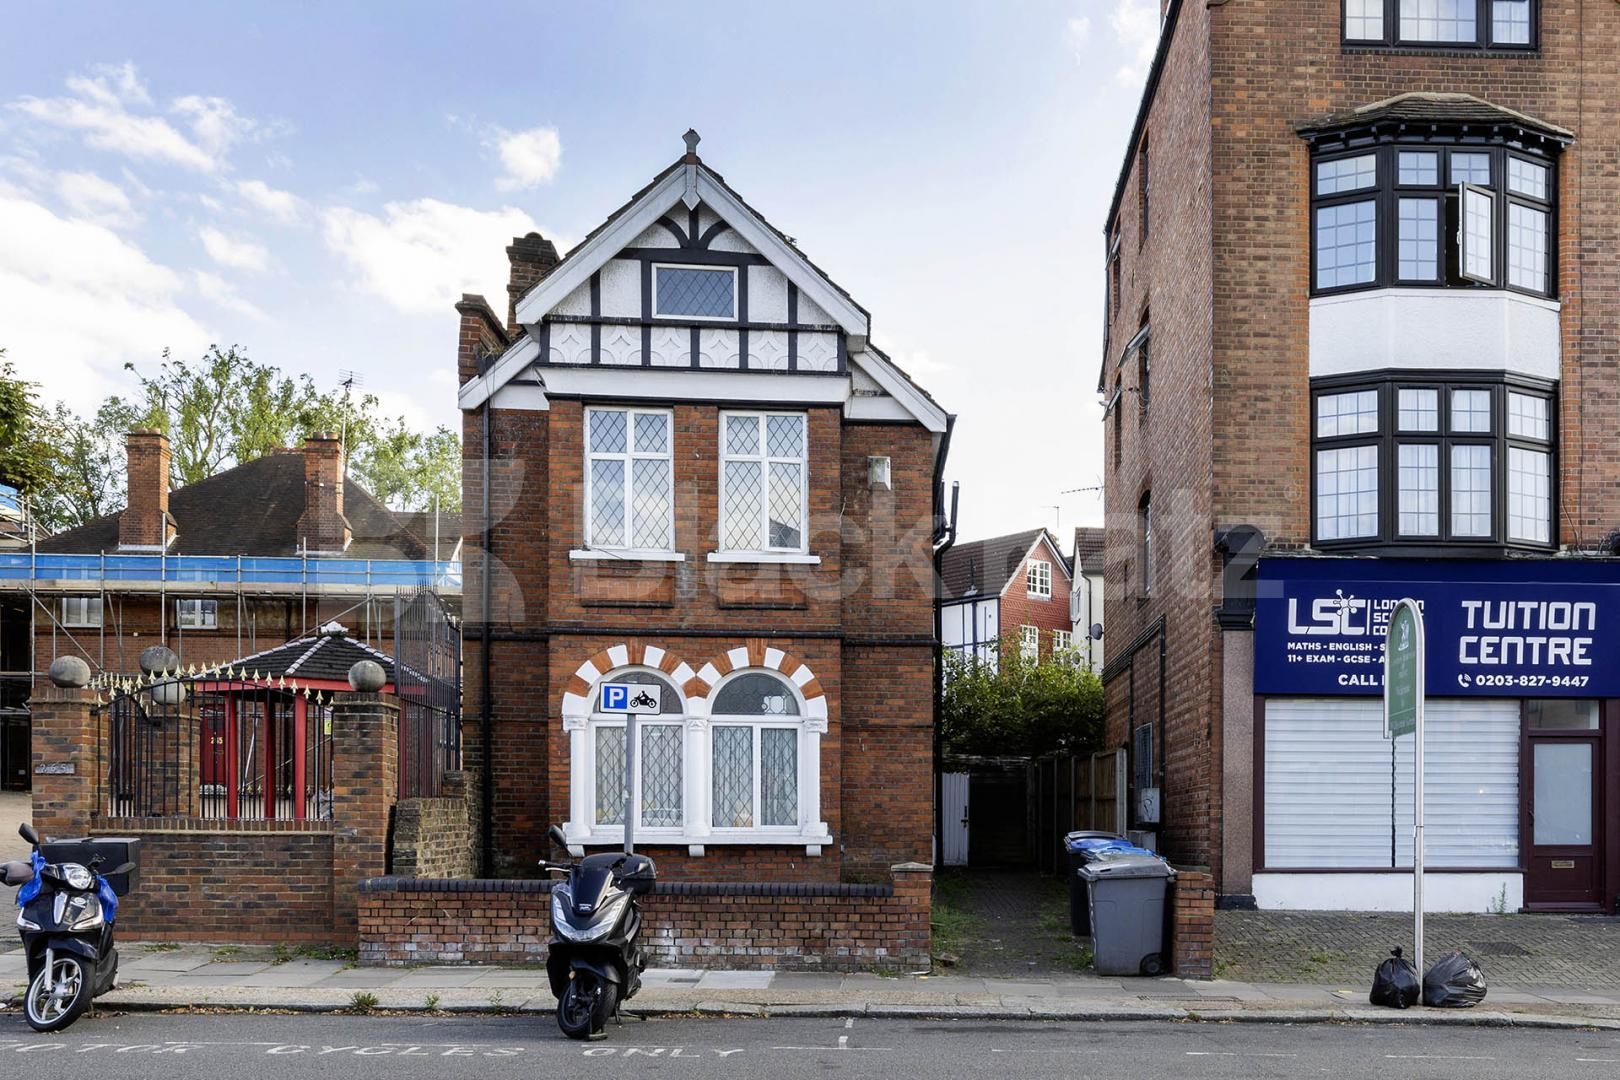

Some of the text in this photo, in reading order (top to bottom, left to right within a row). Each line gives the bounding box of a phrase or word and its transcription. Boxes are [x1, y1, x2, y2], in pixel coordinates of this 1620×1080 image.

[1373, 599, 1424, 610] LONN
[1287, 597, 1366, 636] LSC
[1461, 600, 1596, 631] TUITION
[1287, 642, 1322, 651] MATHS
[1328, 642, 1372, 651] ENGLISH
[1459, 635, 1592, 666] CENTRE
[1287, 654, 1303, 663] 11+
[1306, 654, 1336, 663] EXAM
[1343, 655, 1371, 664] GCSE
[1337, 674, 1379, 687] CALL
[1475, 674, 1590, 688] 0203-827-9447
[609, 687, 625, 708] P
[266, 1044, 526, 1056] CYCLES
[582, 1047, 745, 1058] ONLY
